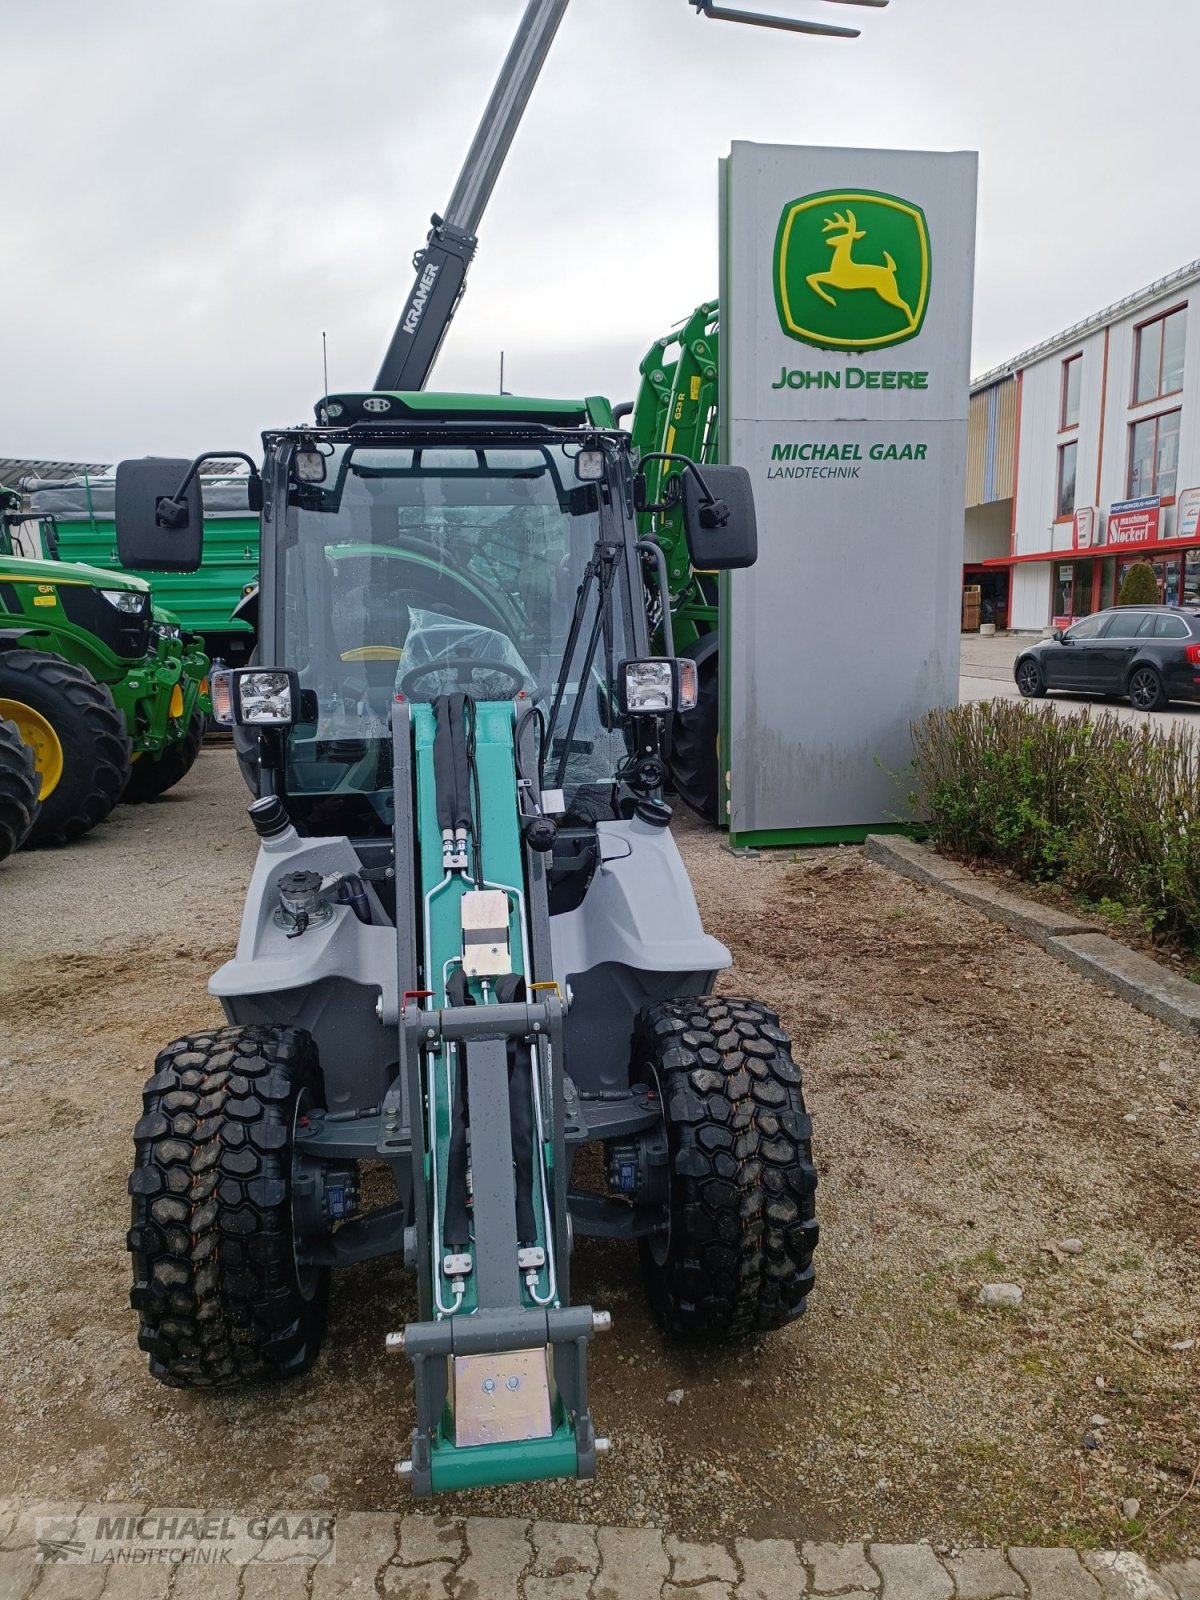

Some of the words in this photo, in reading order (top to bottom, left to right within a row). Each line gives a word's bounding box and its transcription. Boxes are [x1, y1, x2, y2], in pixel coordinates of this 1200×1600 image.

[402, 263, 439, 334] KRAMER
[771, 367, 841, 389] JOHN
[845, 368, 929, 389] DEERE
[678, 393, 685, 401] R
[771, 444, 863, 461] MICHAEL
[869, 444, 928, 460] GAAR
[767, 467, 860, 479] LANDTECHNIK
[1120, 513, 1149, 525] maschinen
[38, 585, 54, 593] 6R
